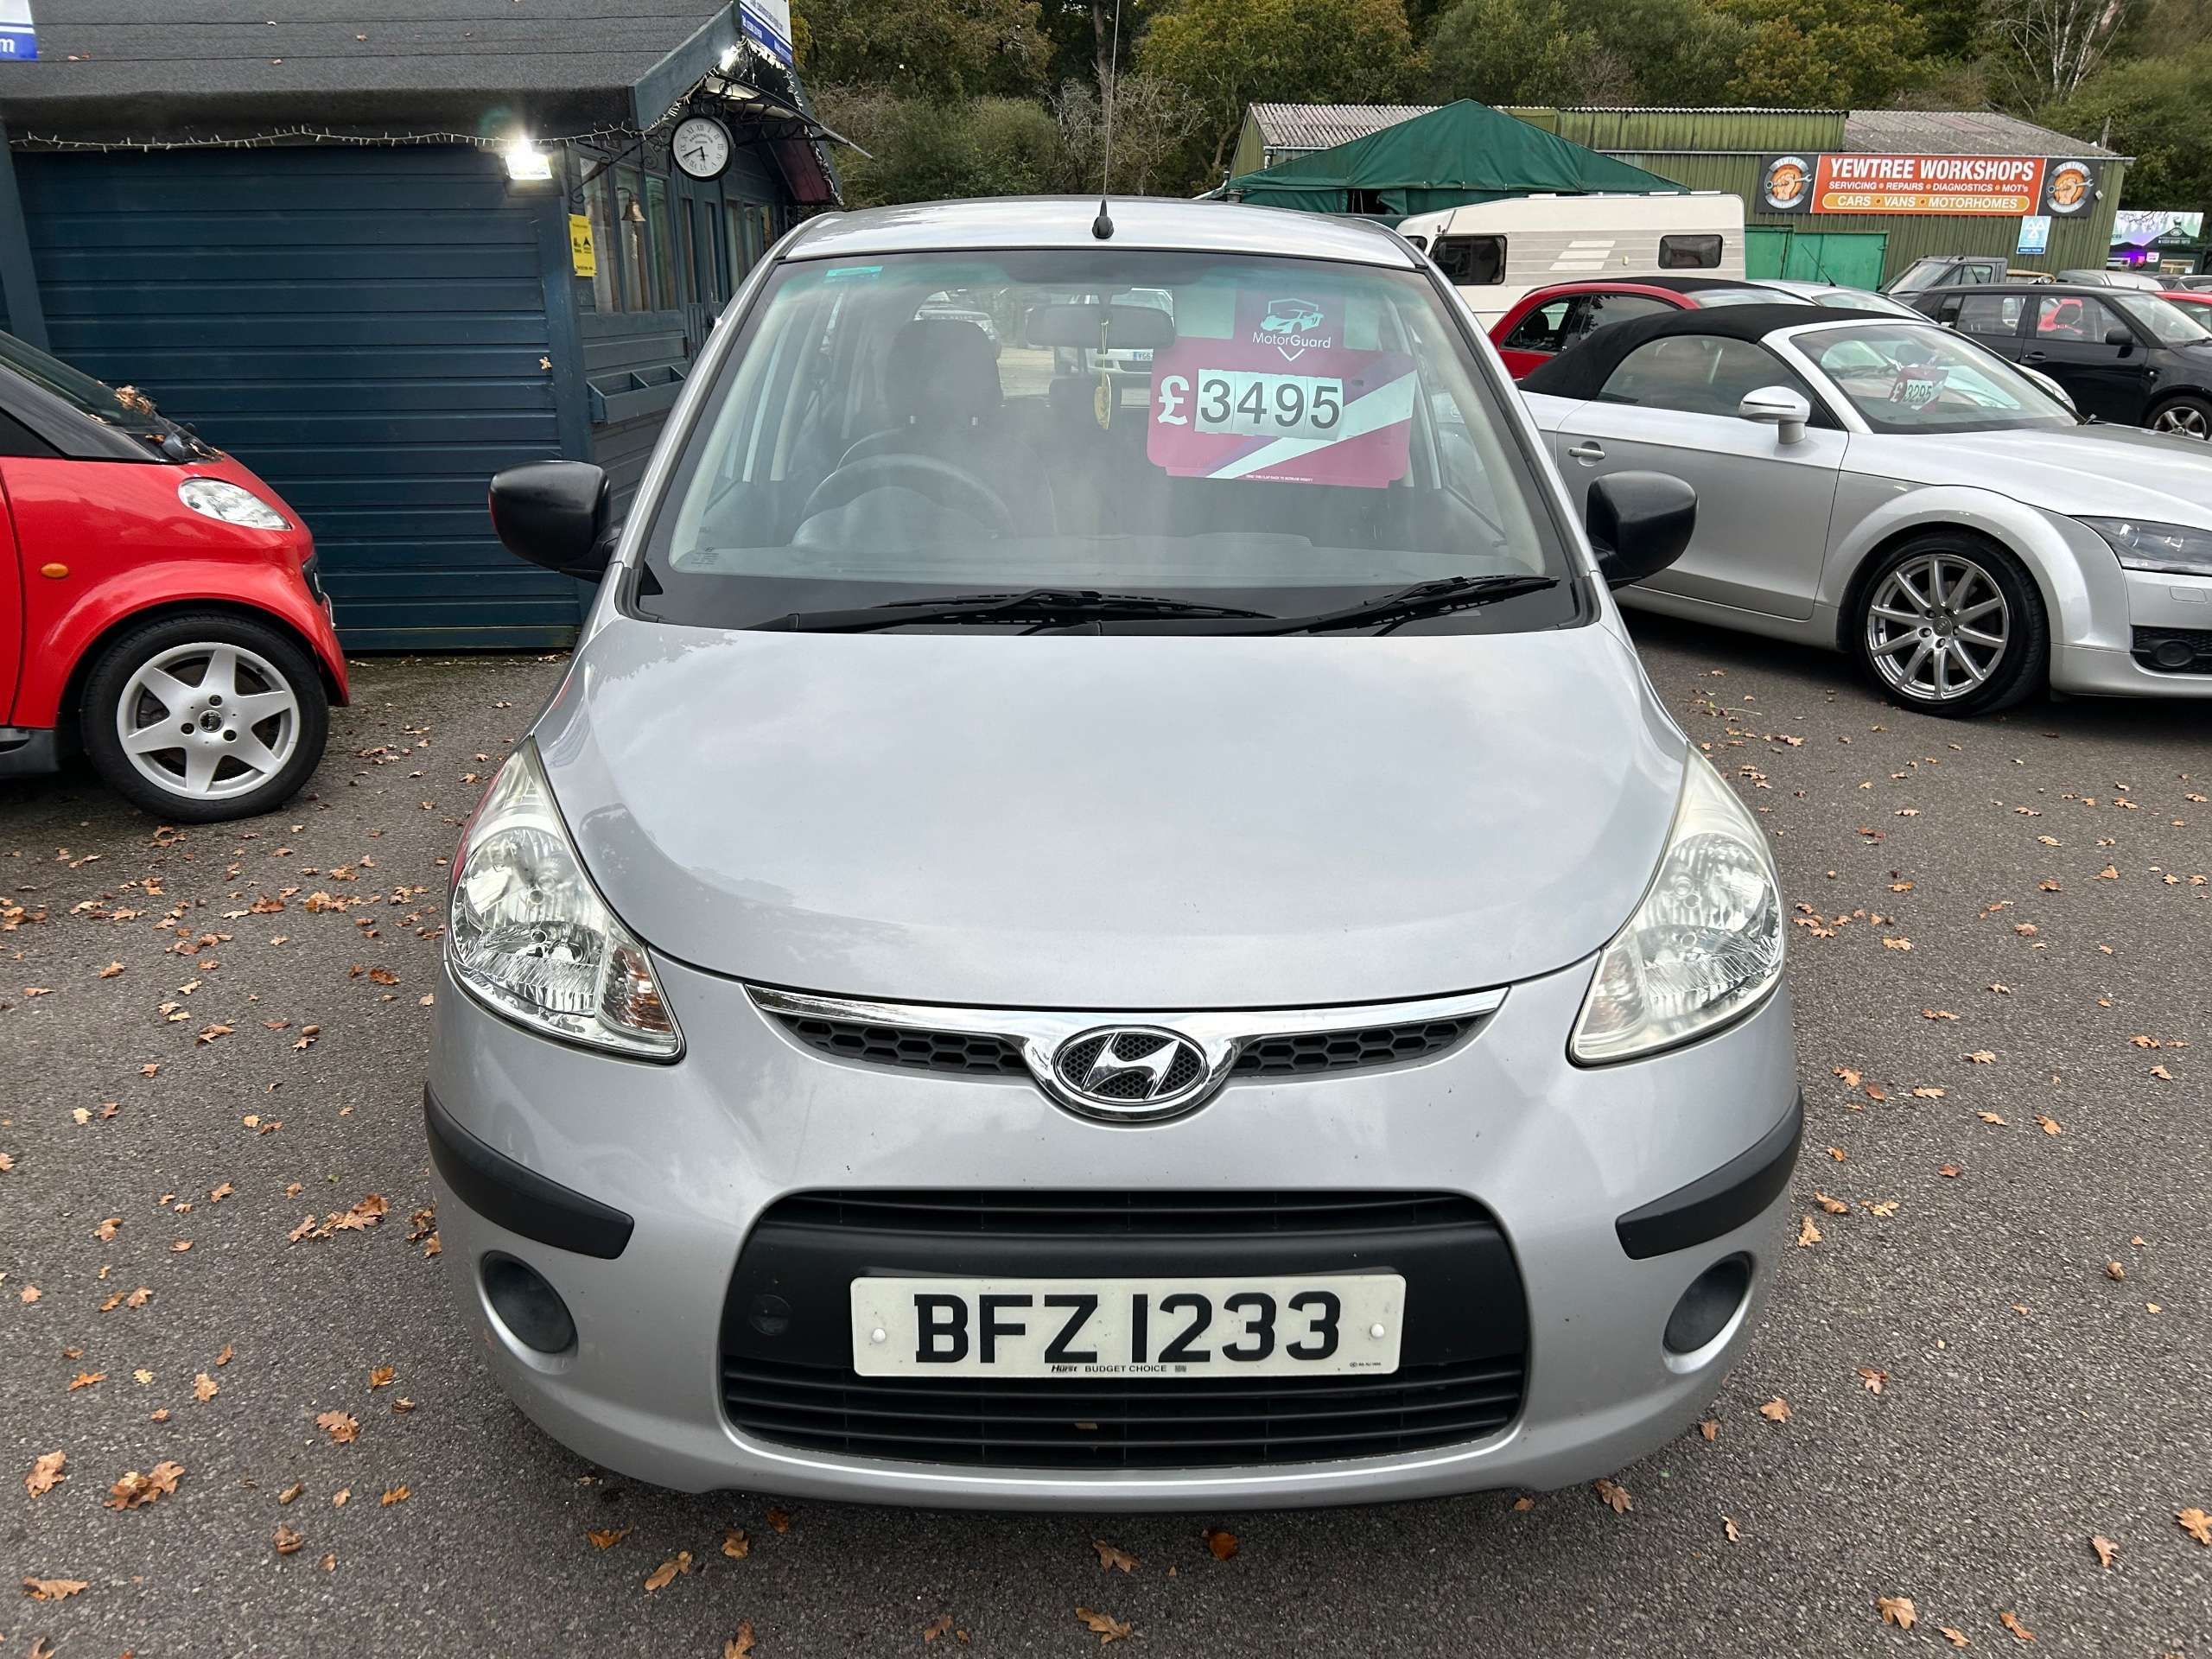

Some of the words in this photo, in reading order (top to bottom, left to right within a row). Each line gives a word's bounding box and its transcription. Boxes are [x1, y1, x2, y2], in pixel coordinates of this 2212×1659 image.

[1830, 158, 1916, 179] YEWTREE
[1919, 159, 2035, 181] WORKSHOPS
[1828, 181, 1877, 190] SERVICING
[1885, 182, 1924, 191] REPAIRS
[1932, 182, 1993, 192] DIAGNOSTICS
[1837, 195, 1872, 207] CARS
[1884, 196, 1916, 207] VANS
[1928, 197, 2018, 209] MOTORHOMES
[1252, 332, 1332, 349] MotorGuard
[1157, 374, 1340, 429] £3495
[914, 1294, 1098, 1363] BFZ
[1131, 1291, 1342, 1363] 1233
[1084, 1364, 1126, 1373] BUDGET
